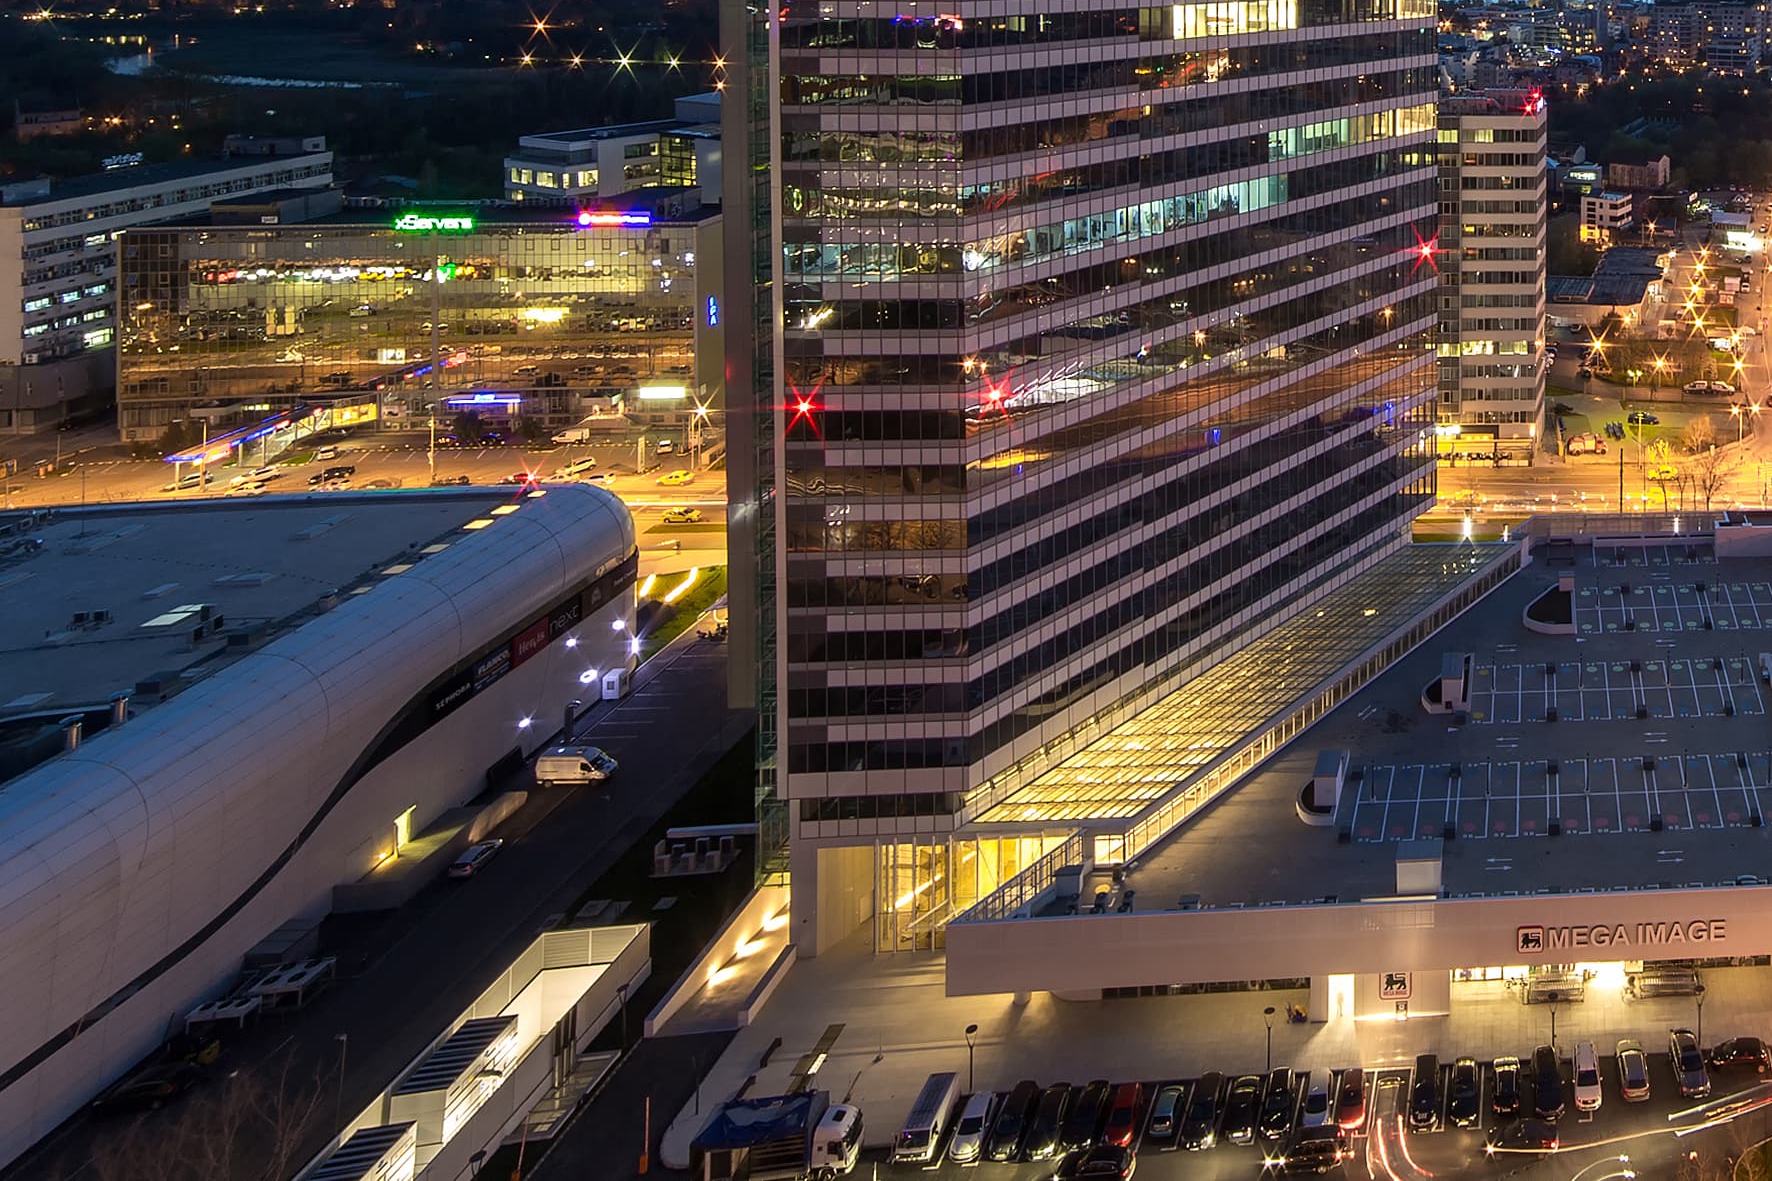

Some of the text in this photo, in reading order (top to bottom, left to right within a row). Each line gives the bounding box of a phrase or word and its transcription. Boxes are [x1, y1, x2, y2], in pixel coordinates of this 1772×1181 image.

[549, 605, 578, 635] next
[435, 682, 471, 710] SEPHORA
[1548, 919, 1726, 949] MEGA IMAGE
